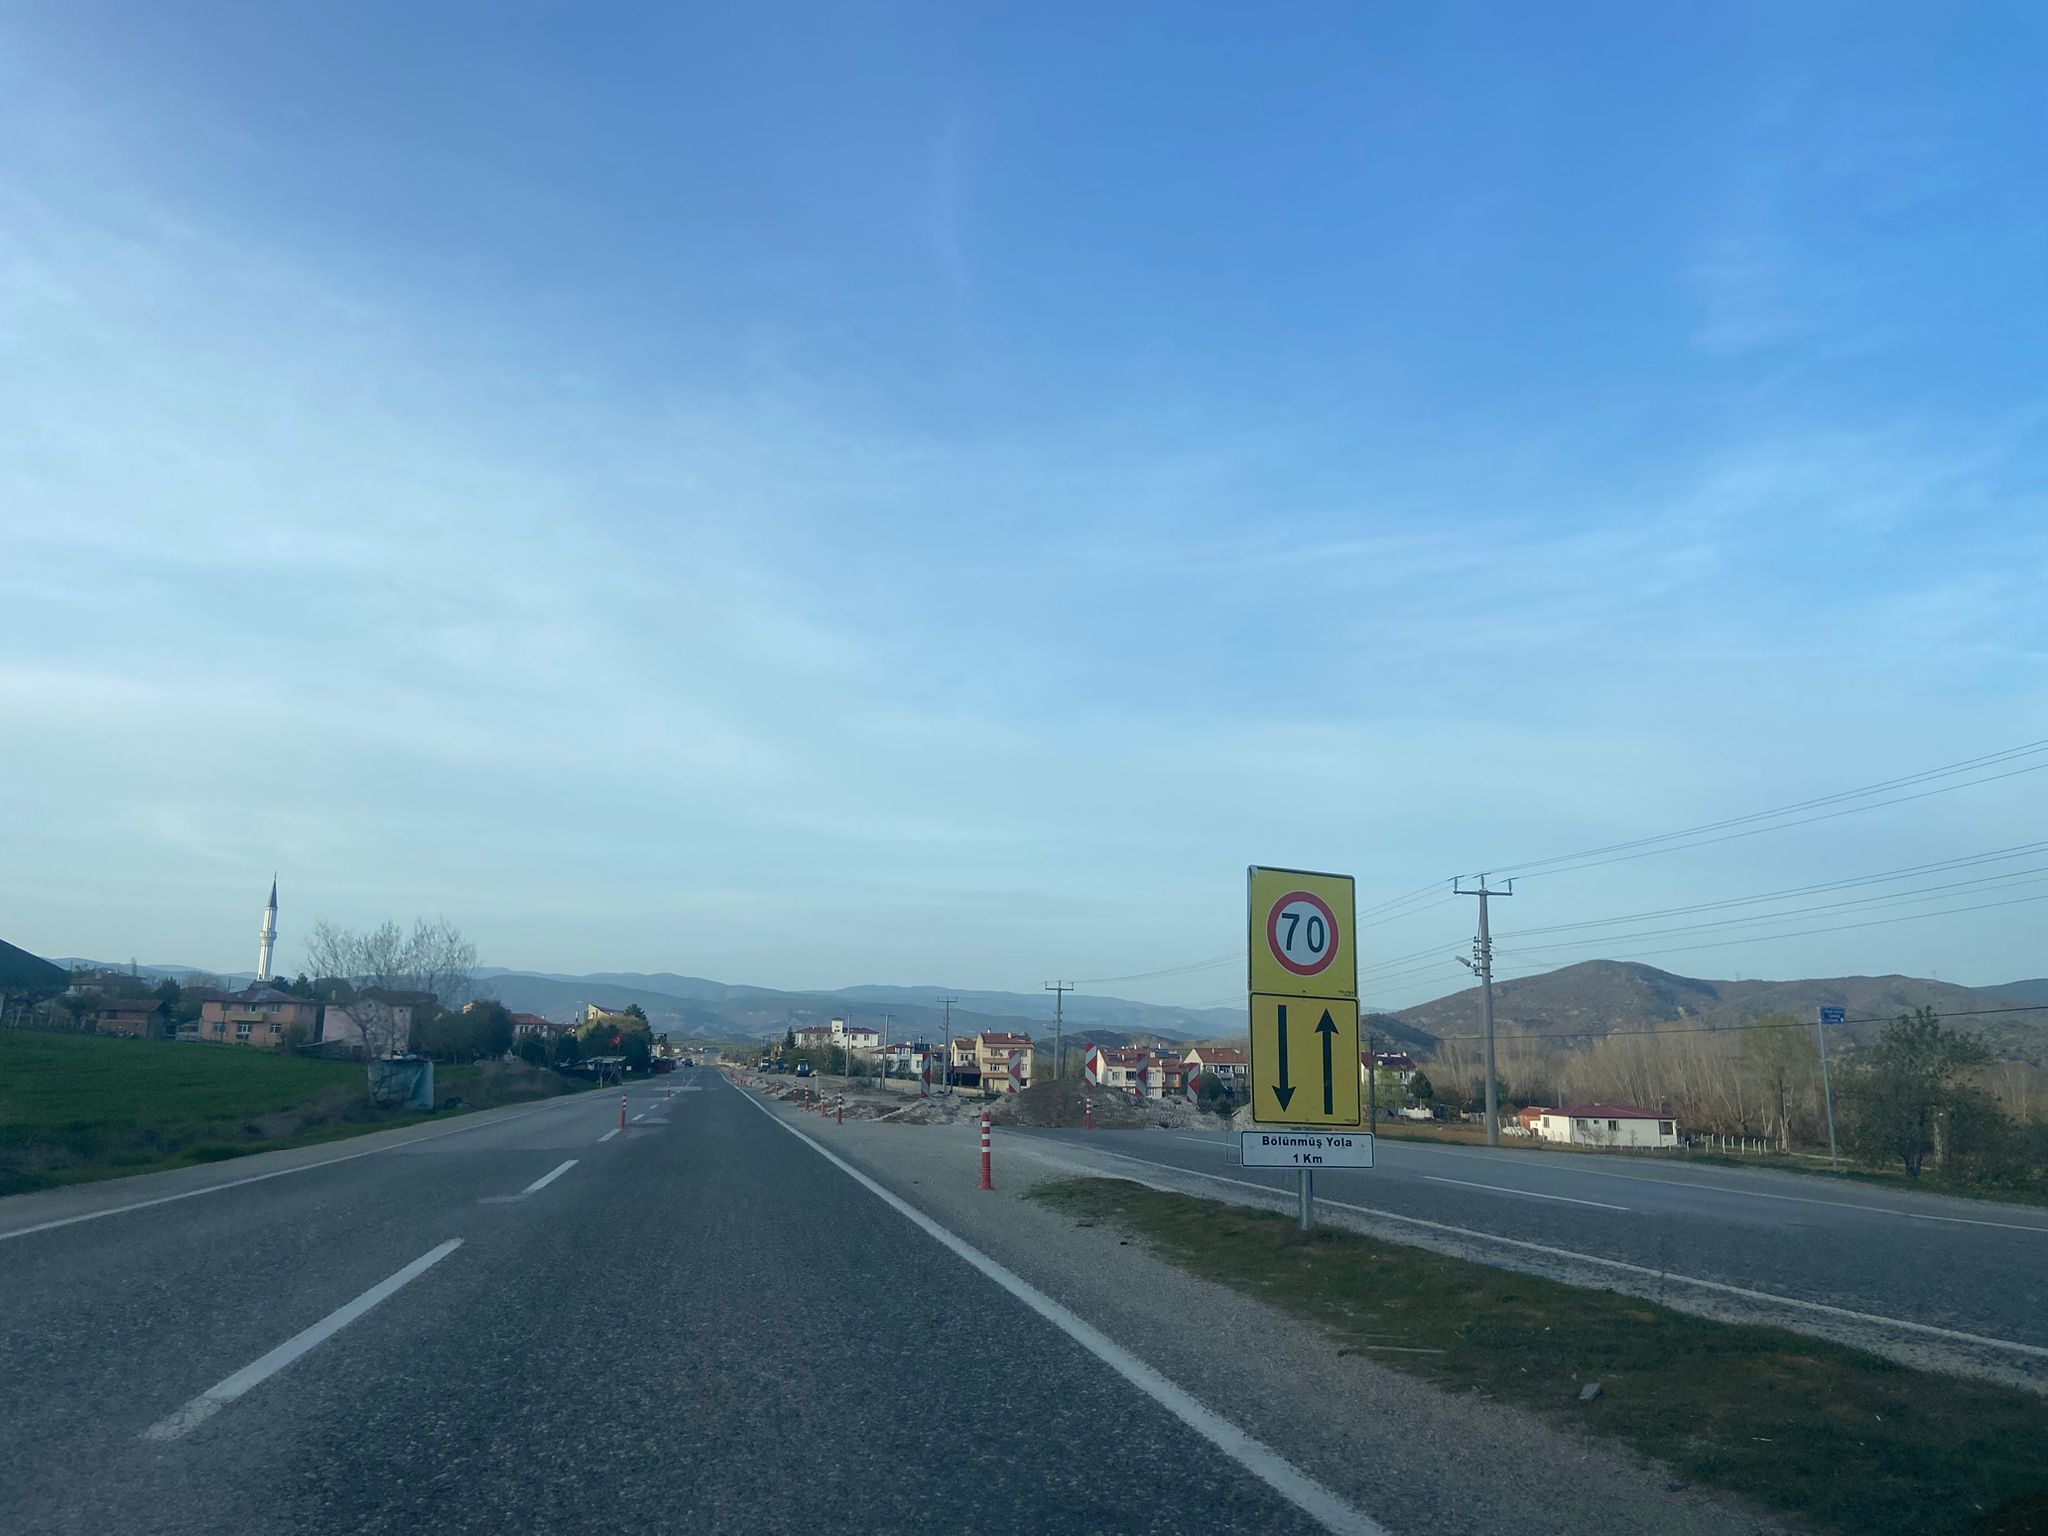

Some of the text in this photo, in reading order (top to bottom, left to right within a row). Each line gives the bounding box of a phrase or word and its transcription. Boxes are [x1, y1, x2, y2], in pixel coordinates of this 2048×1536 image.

[1281, 912, 1325, 953] 70
[1262, 1136, 1352, 1149] Bölünmüş Yola
[1293, 1153, 1323, 1163] 1 Km
